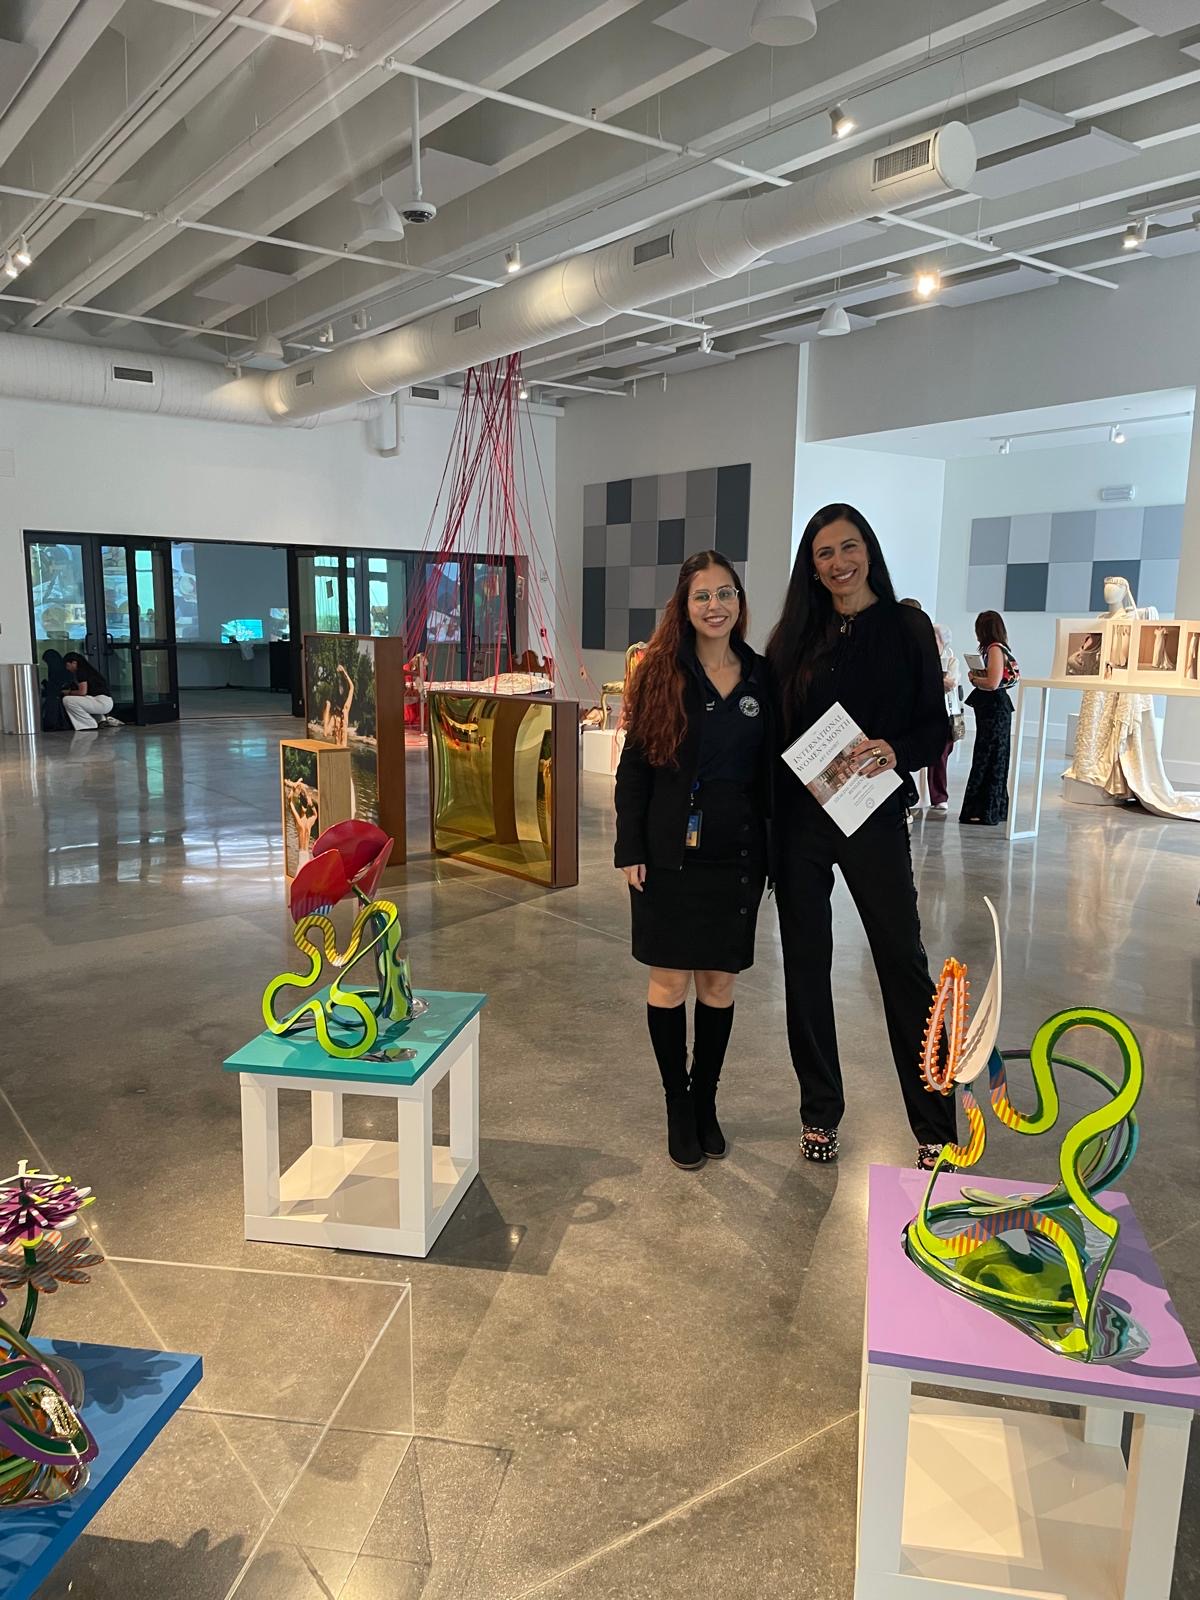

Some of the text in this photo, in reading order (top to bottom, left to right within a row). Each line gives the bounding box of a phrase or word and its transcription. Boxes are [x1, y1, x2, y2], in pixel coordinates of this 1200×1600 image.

[793, 715, 844, 764] INTERNATIONAL
[796, 719, 851, 772] WOMEN'S MONTH
